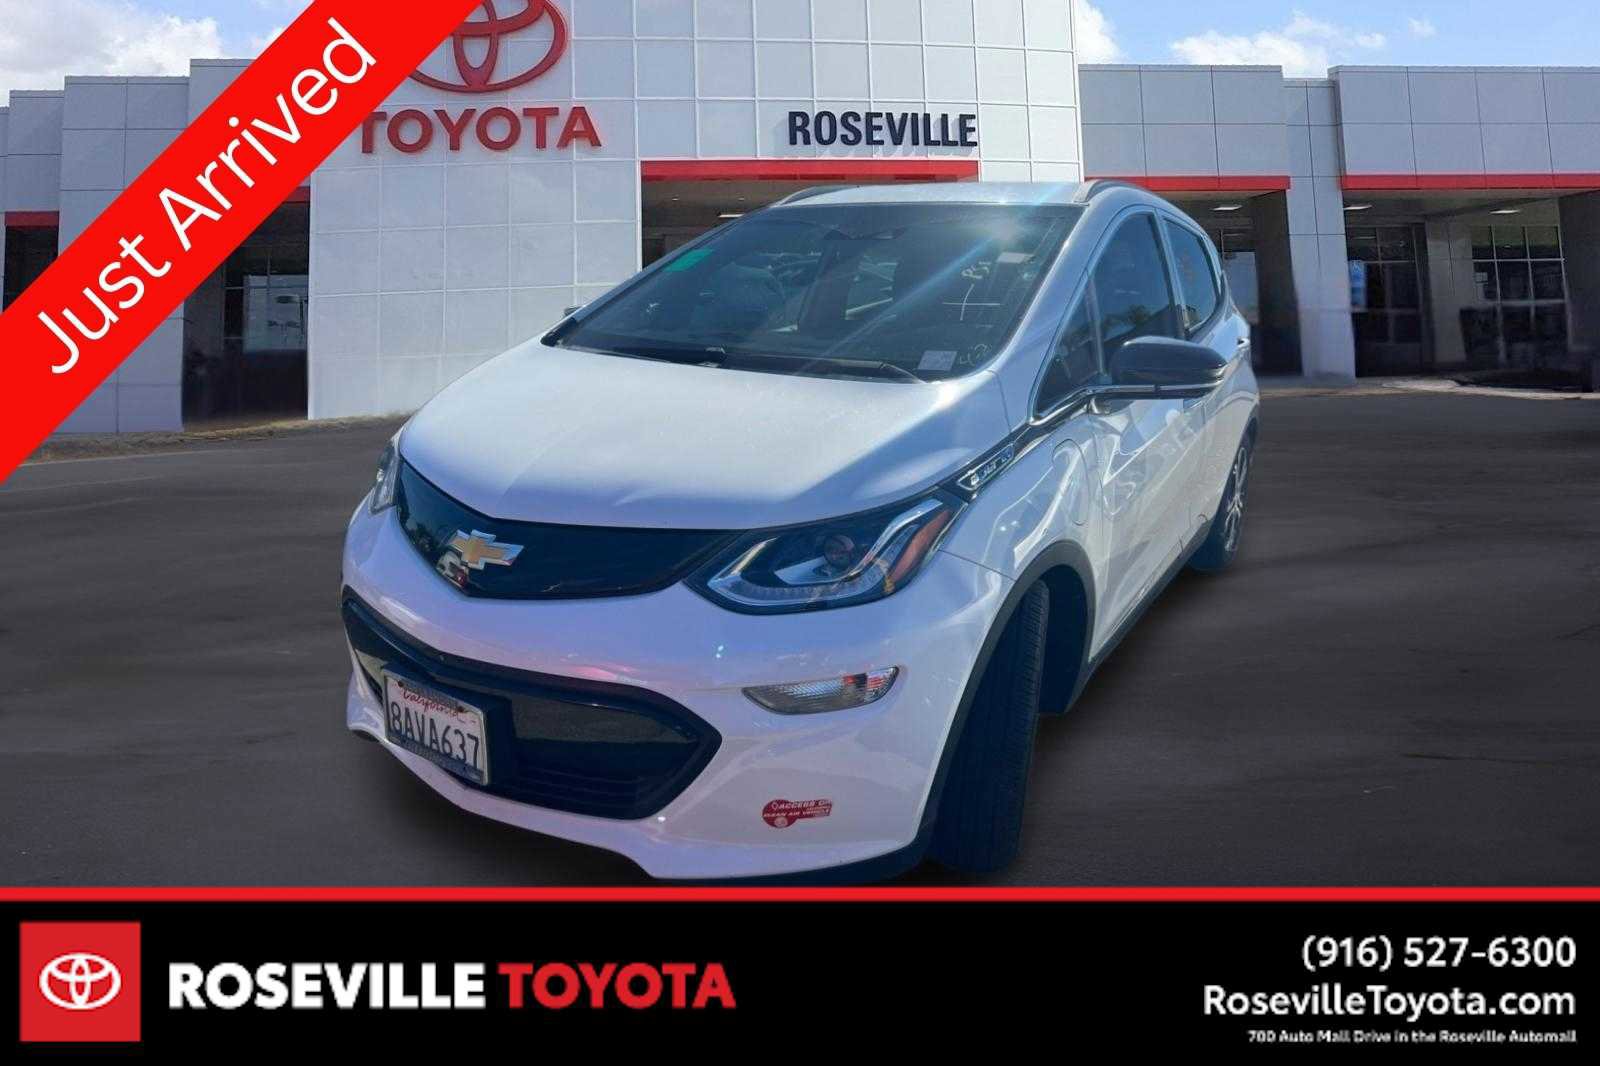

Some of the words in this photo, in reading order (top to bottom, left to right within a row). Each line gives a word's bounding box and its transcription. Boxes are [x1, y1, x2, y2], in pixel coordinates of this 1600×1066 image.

[361, 106, 602, 154] TOYOTA
[788, 111, 978, 147] ROSEVILLE
[390, 701, 479, 770] 8AVA637
